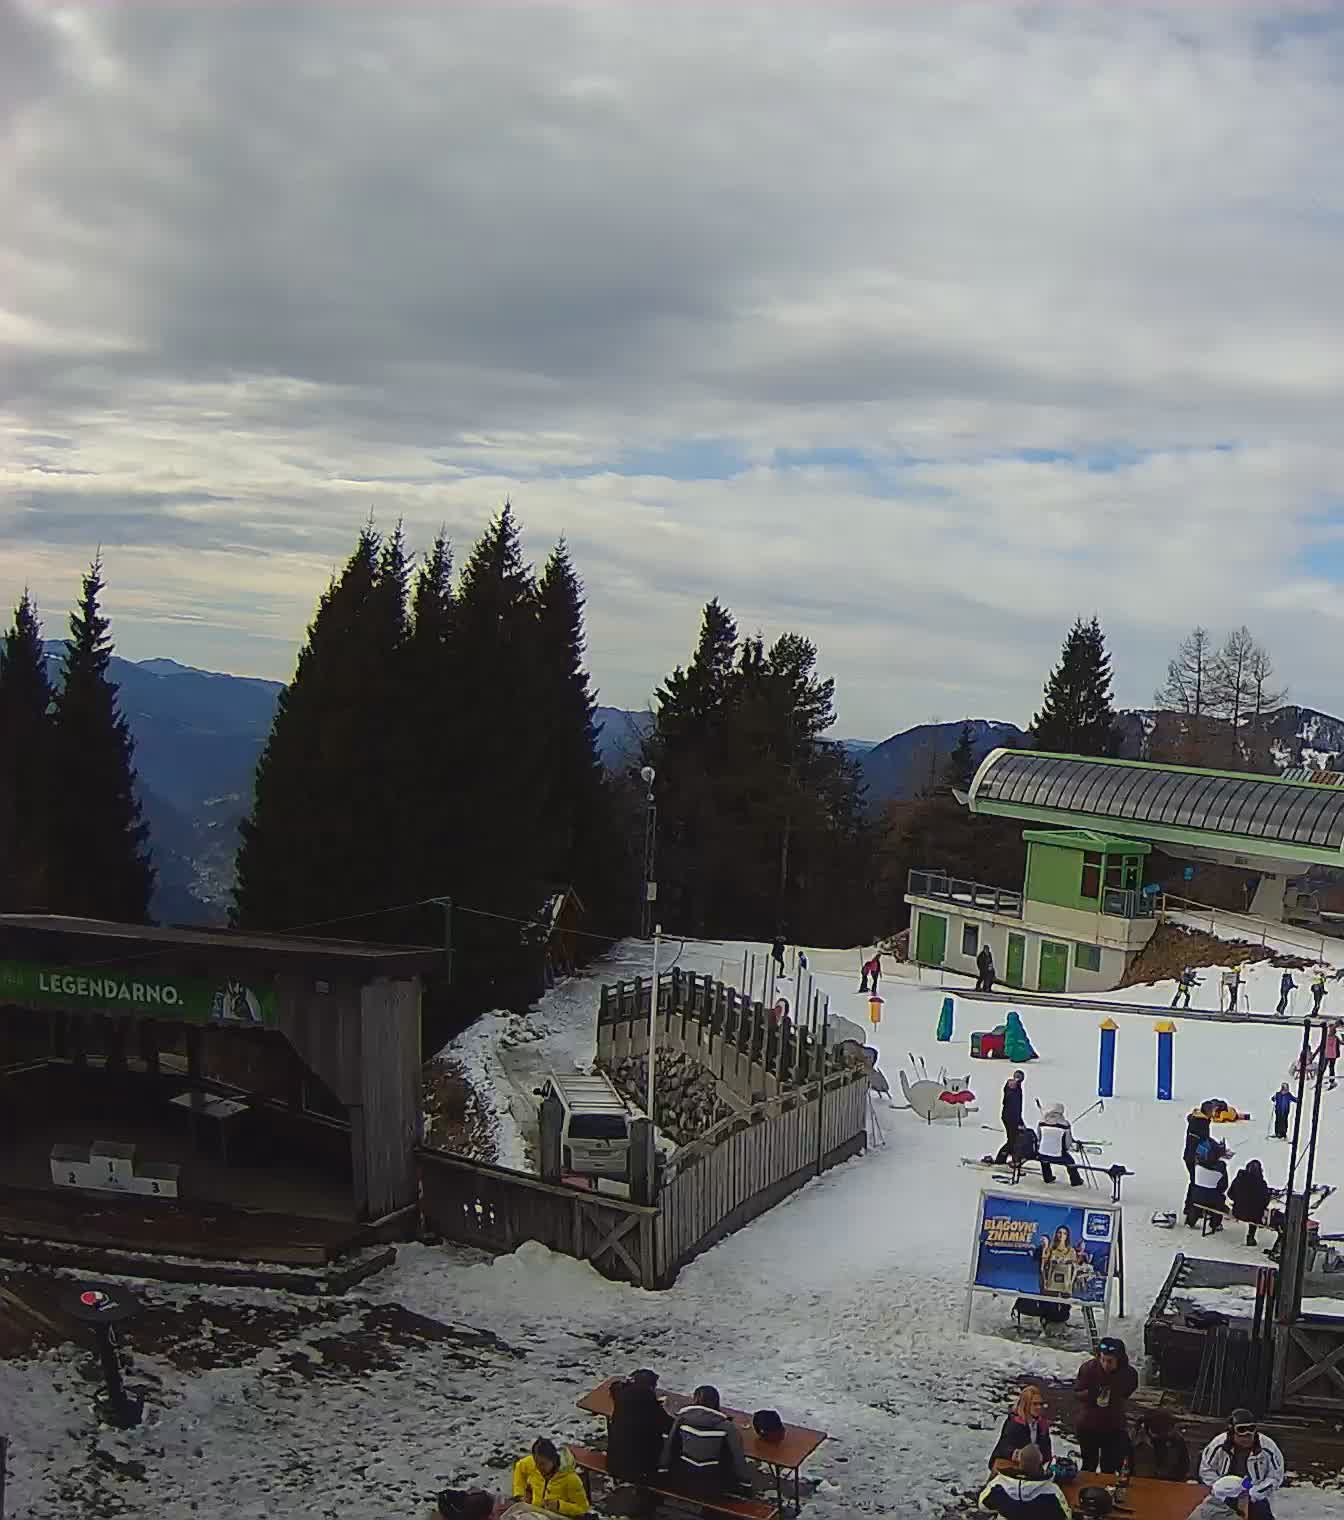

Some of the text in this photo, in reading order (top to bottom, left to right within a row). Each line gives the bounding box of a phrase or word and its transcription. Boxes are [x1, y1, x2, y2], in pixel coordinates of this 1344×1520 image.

[39, 973, 184, 1005] LEGENDARNO.
[68, 1171, 76, 1184] 2
[151, 1182, 160, 1194] 3
